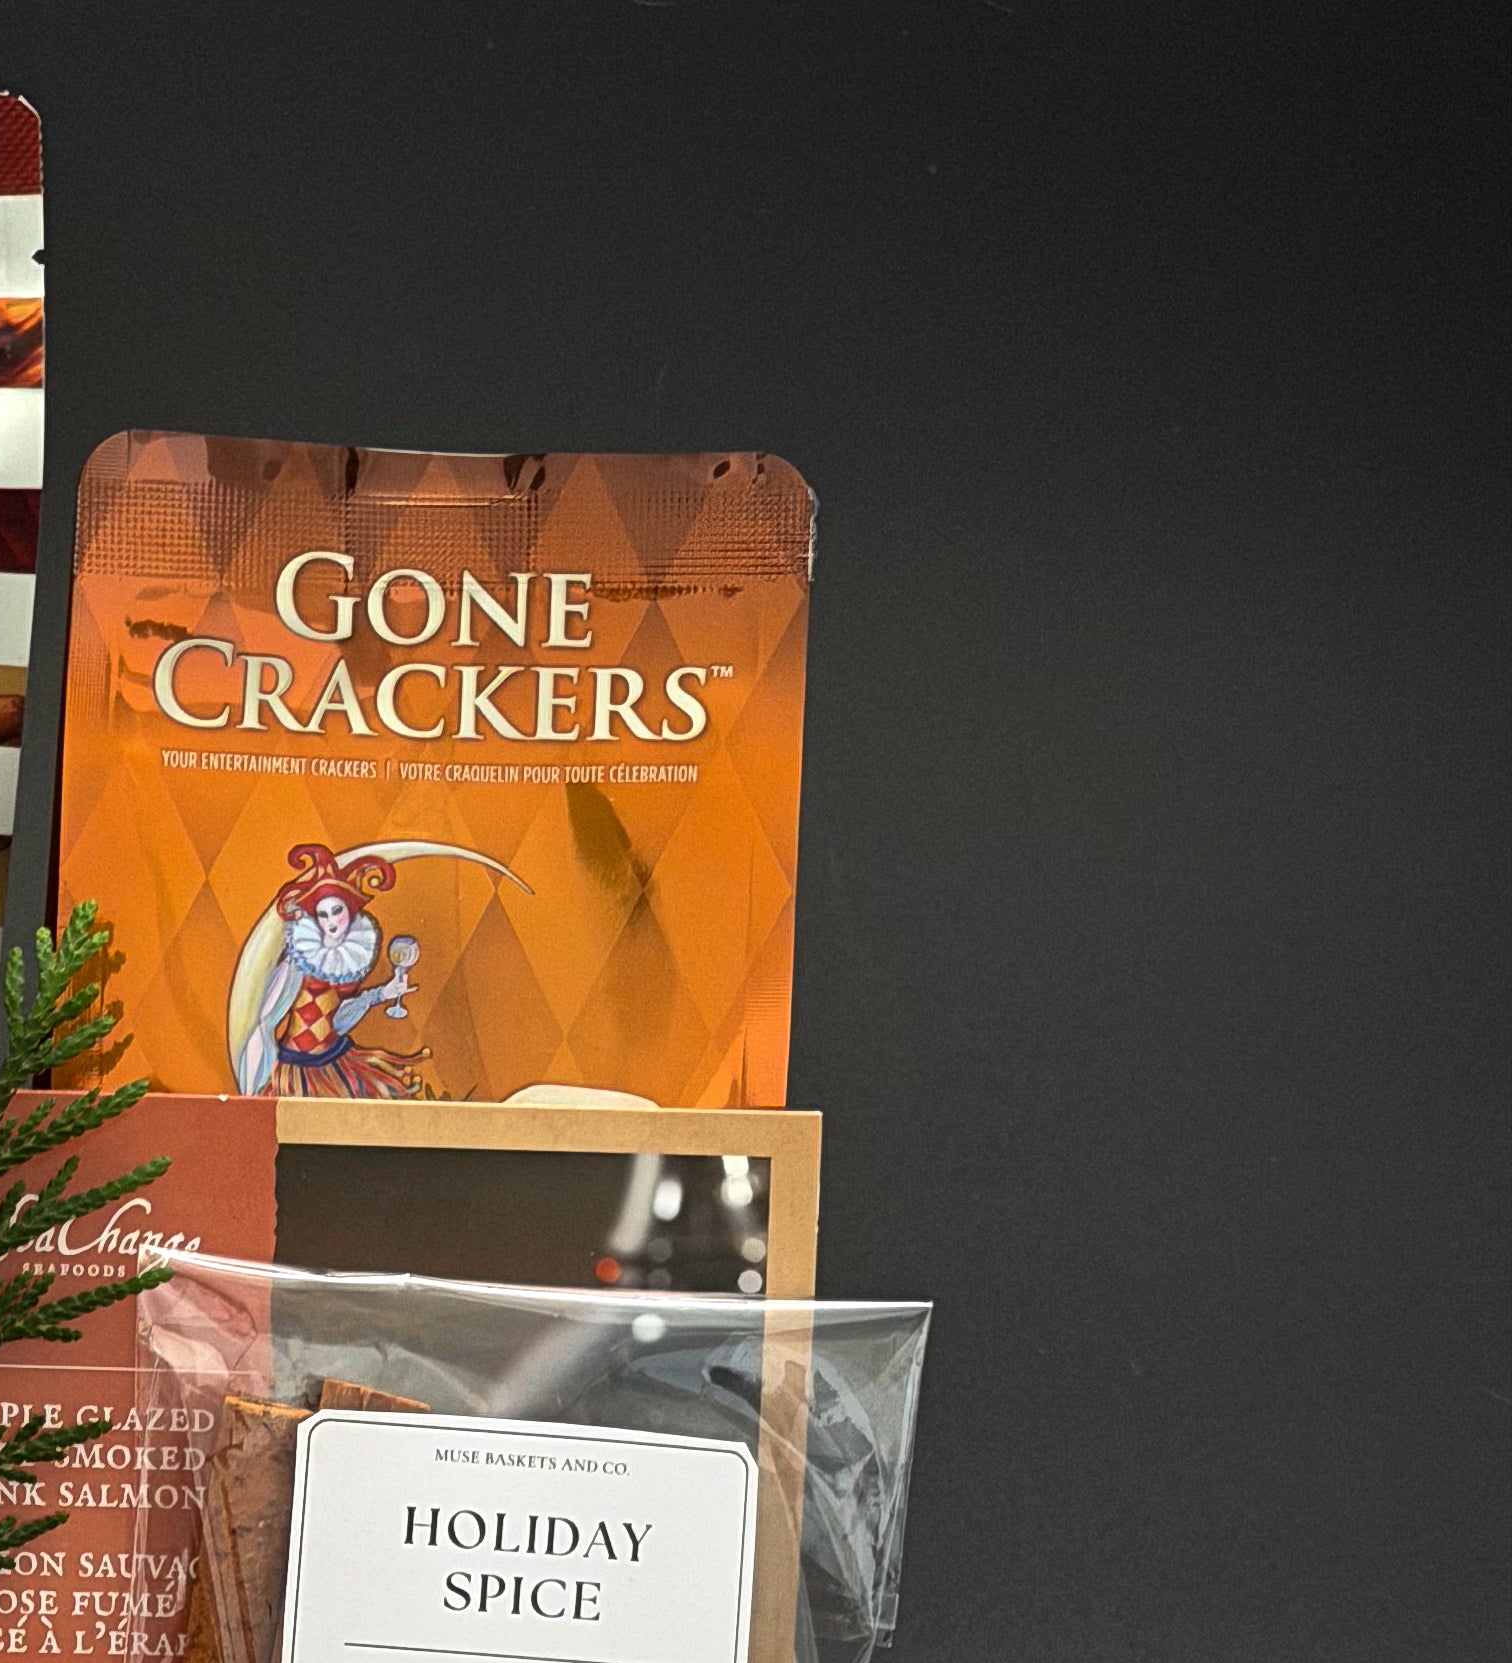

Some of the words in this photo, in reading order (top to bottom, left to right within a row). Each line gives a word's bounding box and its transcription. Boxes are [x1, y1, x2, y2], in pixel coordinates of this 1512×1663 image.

[275, 550, 593, 649] GONE
[161, 750, 197, 768] YOUR
[201, 753, 307, 775] ENTERTAINMENT
[311, 758, 377, 778] CRACKERS
[399, 762, 441, 781] VOTRE
[445, 764, 519, 784] CRAQUELIN
[523, 766, 560, 784] POUR
[564, 765, 605, 784] TOUTE
[22, 1263, 126, 1278] SEAFOODS
[76, 1405, 215, 1432] GLAZED
[434, 1448, 480, 1464] MUSE
[486, 1452, 557, 1470] BASKETS
[561, 1458, 598, 1474] AND
[602, 1461, 631, 1477] CO.
[58, 1481, 207, 1510] SALMON
[403, 1505, 653, 1563] HOLIDAY
[71, 1580, 176, 1618] FUMÉ
[443, 1571, 602, 1621] SPICE
[38, 1615, 62, 1654] À
